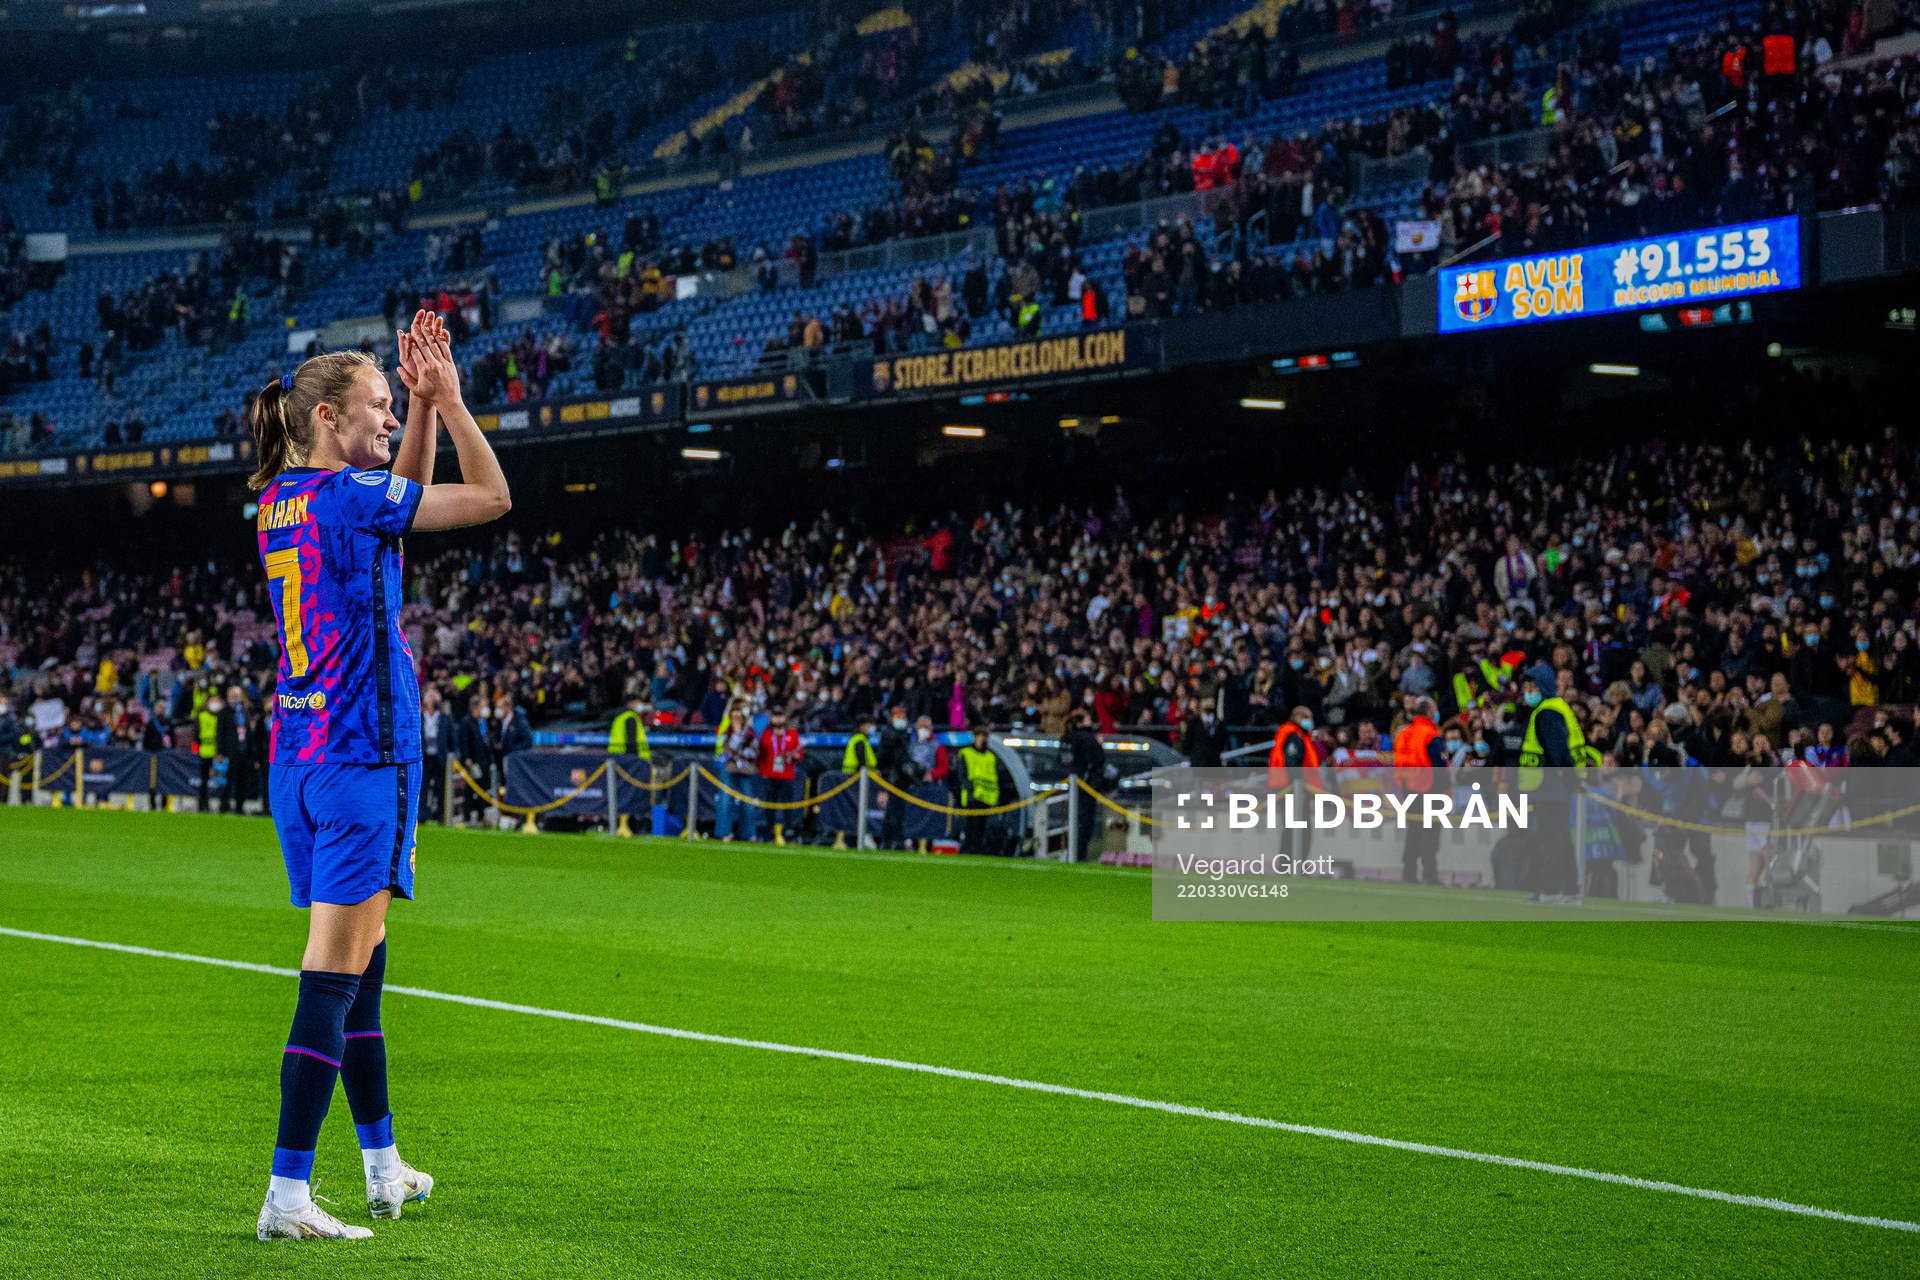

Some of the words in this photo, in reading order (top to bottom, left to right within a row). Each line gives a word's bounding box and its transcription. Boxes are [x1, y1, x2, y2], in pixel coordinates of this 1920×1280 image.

[1505, 254, 1583, 292] AVUI
[1614, 227, 1770, 285] #91.553
[1513, 284, 1583, 319] SOM
[1690, 269, 1780, 296] MUNDIAL
[893, 330, 1125, 391] STORE.FCBARCELONA.COM
[264, 547, 309, 678] 7
[278, 692, 312, 709] nicef
